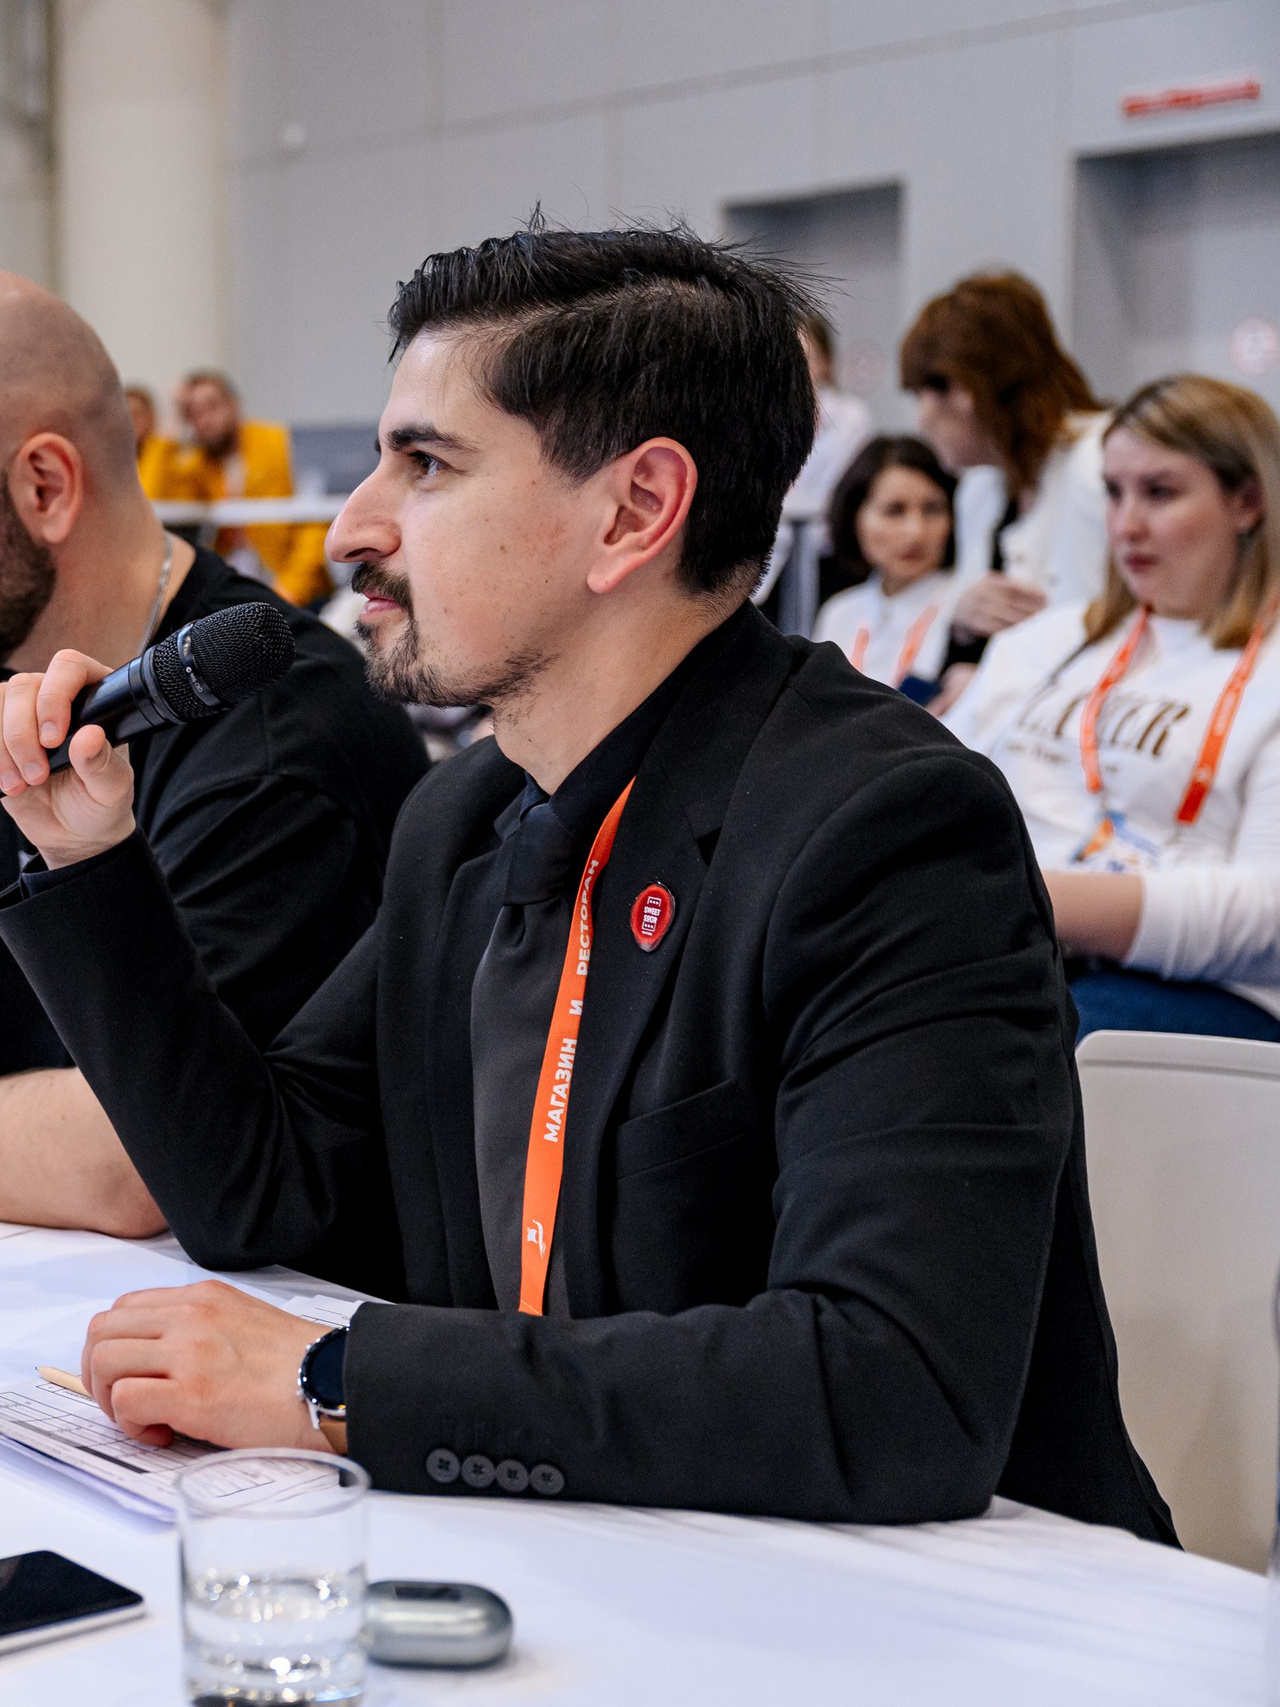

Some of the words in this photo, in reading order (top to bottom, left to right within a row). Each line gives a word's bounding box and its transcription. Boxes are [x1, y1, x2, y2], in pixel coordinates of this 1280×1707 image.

[544, 1038, 577, 1143] МАГАЗИН
[569, 999, 583, 1016] И
[576, 860, 600, 976] РЕСТОРАН
